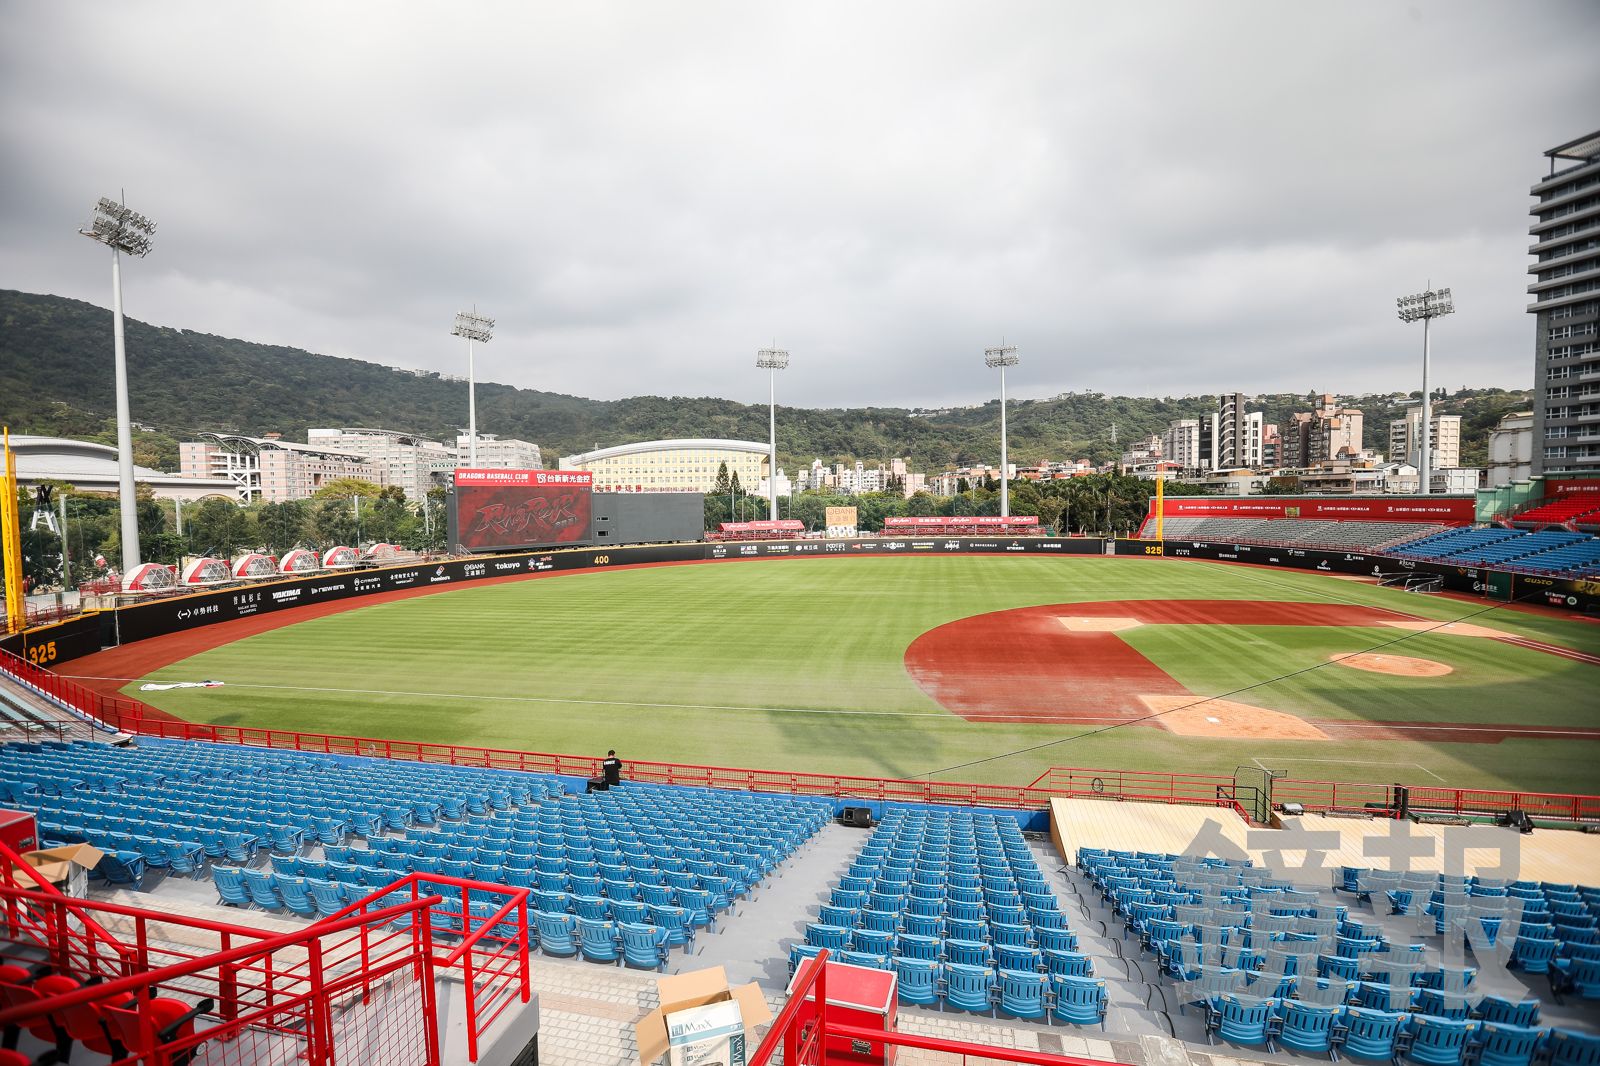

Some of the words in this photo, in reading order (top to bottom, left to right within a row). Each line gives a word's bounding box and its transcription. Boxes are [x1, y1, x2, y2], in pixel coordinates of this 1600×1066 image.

[459, 472, 485, 480] DRAGONS
[548, 474, 591, 484] 台新新光金控
[1145, 546, 1162, 555] 325
[595, 555, 609, 565] 400
[496, 562, 520, 570] tokuyo
[272, 588, 302, 600] YAKIMA
[29, 641, 57, 665] 325
[684, 1018, 713, 1034] MaxX
